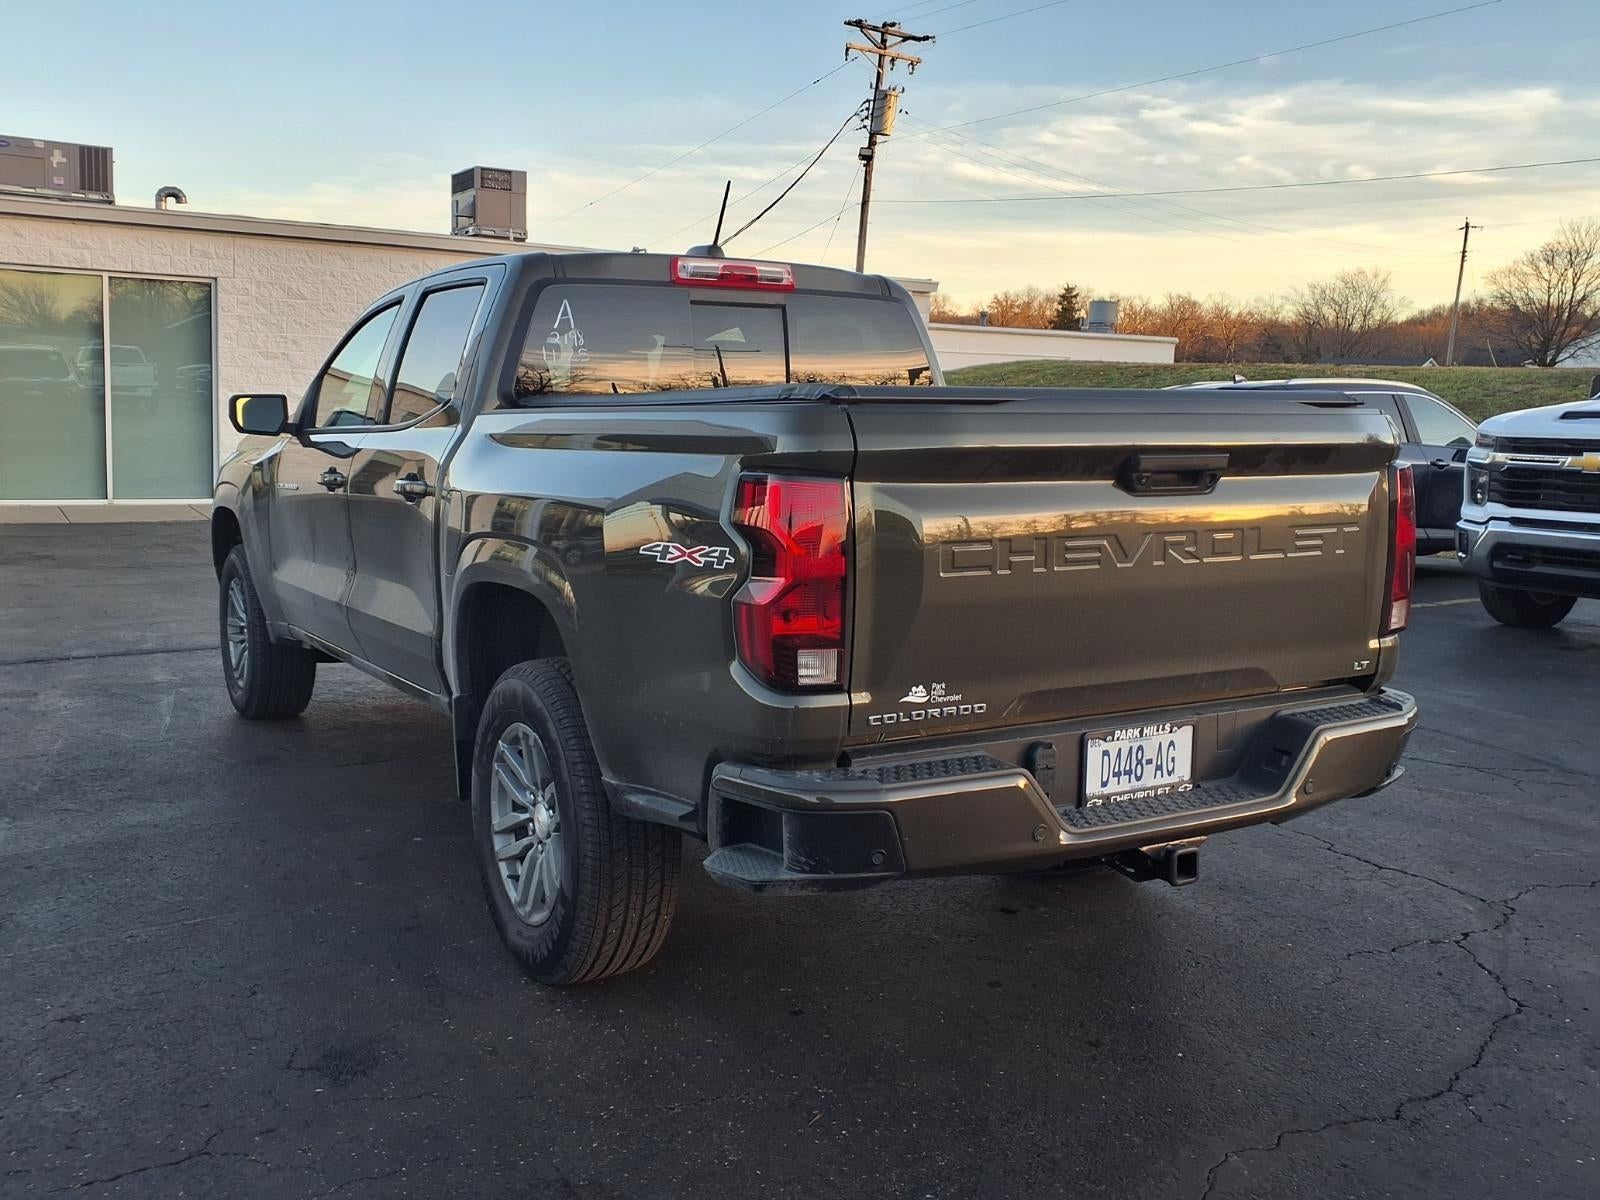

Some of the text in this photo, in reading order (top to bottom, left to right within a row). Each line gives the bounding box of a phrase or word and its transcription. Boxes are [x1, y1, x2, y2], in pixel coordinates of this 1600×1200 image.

[553, 298, 575, 329] A
[939, 521, 1360, 577] CHEVROLET
[1353, 660, 1370, 670] LT
[930, 688, 945, 697] Hills
[931, 682, 946, 690] Park
[930, 694, 962, 703] Chevrolet
[868, 703, 987, 726] COLORADO
[1113, 728, 1142, 741] PARK
[1142, 723, 1171, 737] HILLS
[1100, 739, 1176, 788] D448-AG
